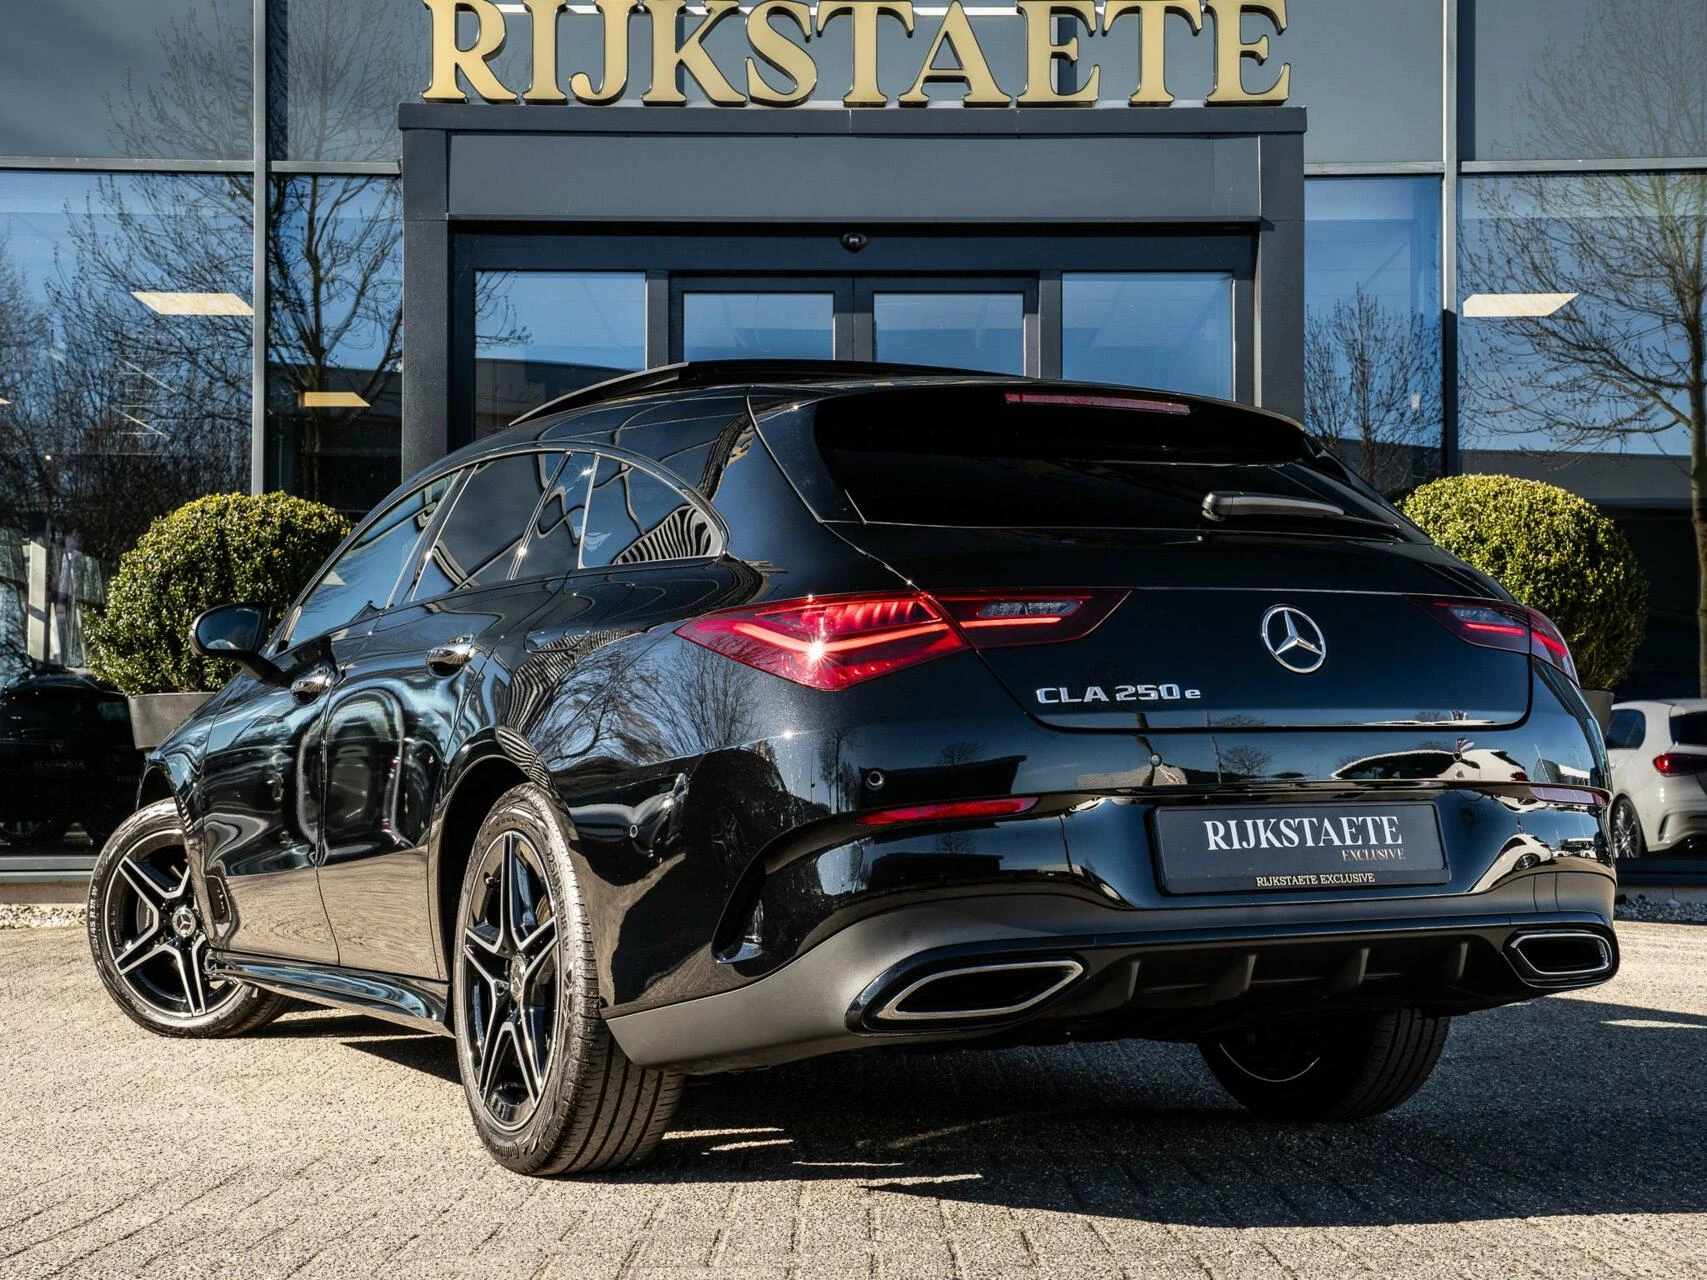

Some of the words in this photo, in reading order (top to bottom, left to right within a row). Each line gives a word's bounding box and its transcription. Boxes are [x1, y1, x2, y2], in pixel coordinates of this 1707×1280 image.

[421, 0, 1291, 107] RIJKSTAETE
[1036, 686, 1110, 704] CLA
[1203, 815, 1403, 851] RIJKSTAETE
[1341, 847, 1406, 862] EXCLUSIVE
[1256, 874, 1319, 887] RIJKSTAETE
[1320, 873, 1376, 885] EXCLUSIVE
